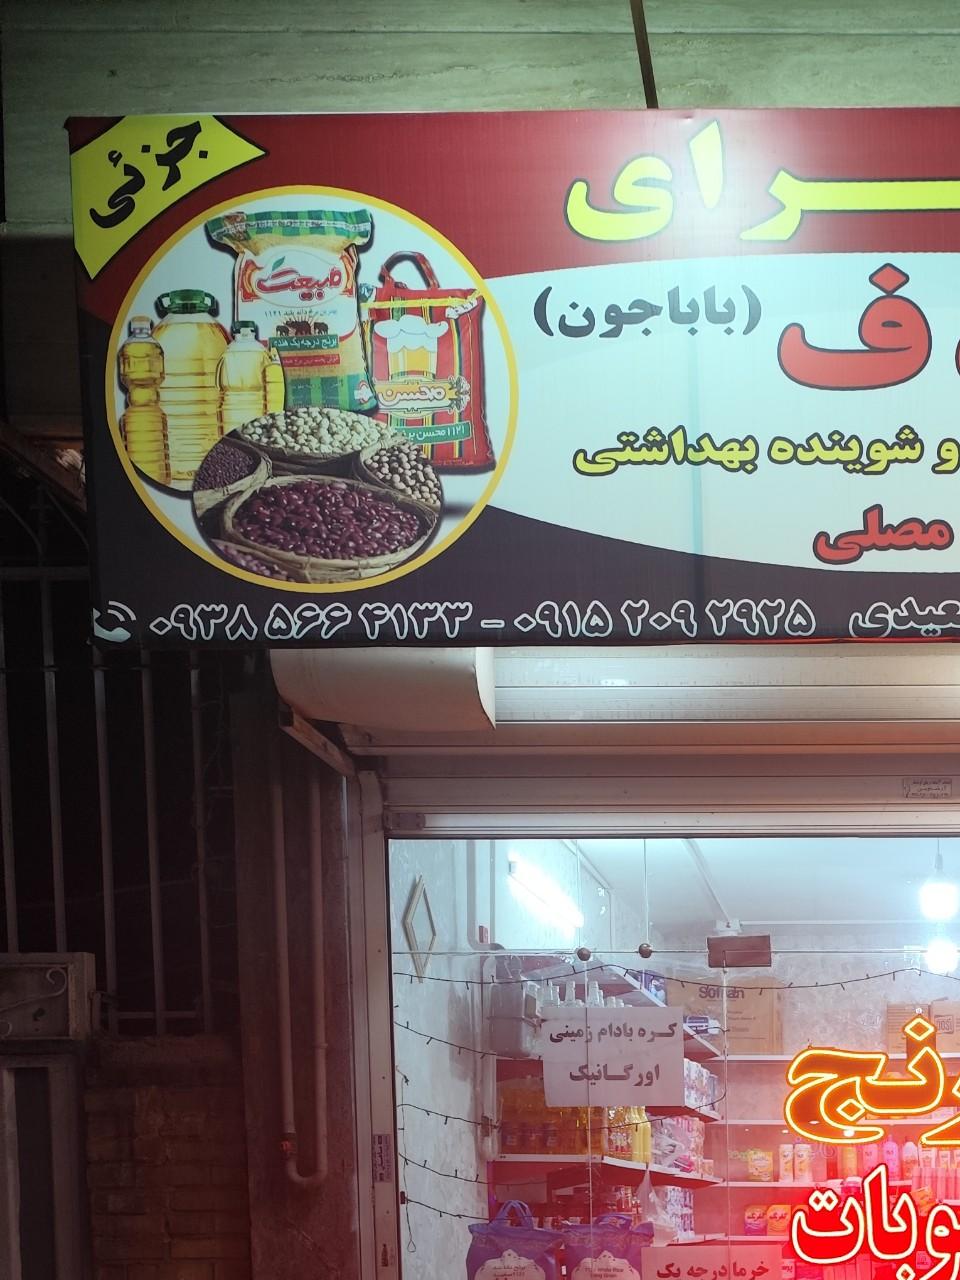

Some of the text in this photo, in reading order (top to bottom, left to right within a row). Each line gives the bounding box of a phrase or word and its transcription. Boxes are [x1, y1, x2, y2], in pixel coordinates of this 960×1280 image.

[89, 120, 208, 227] جزئی
[573, 425, 759, 476] بهداشتی
[768, 426, 923, 474] شوینده
[813, 504, 954, 564] مصلی
[550, 1022, 677, 1043] کره بادام زمینی
[569, 1062, 660, 1086] اورگانیک
